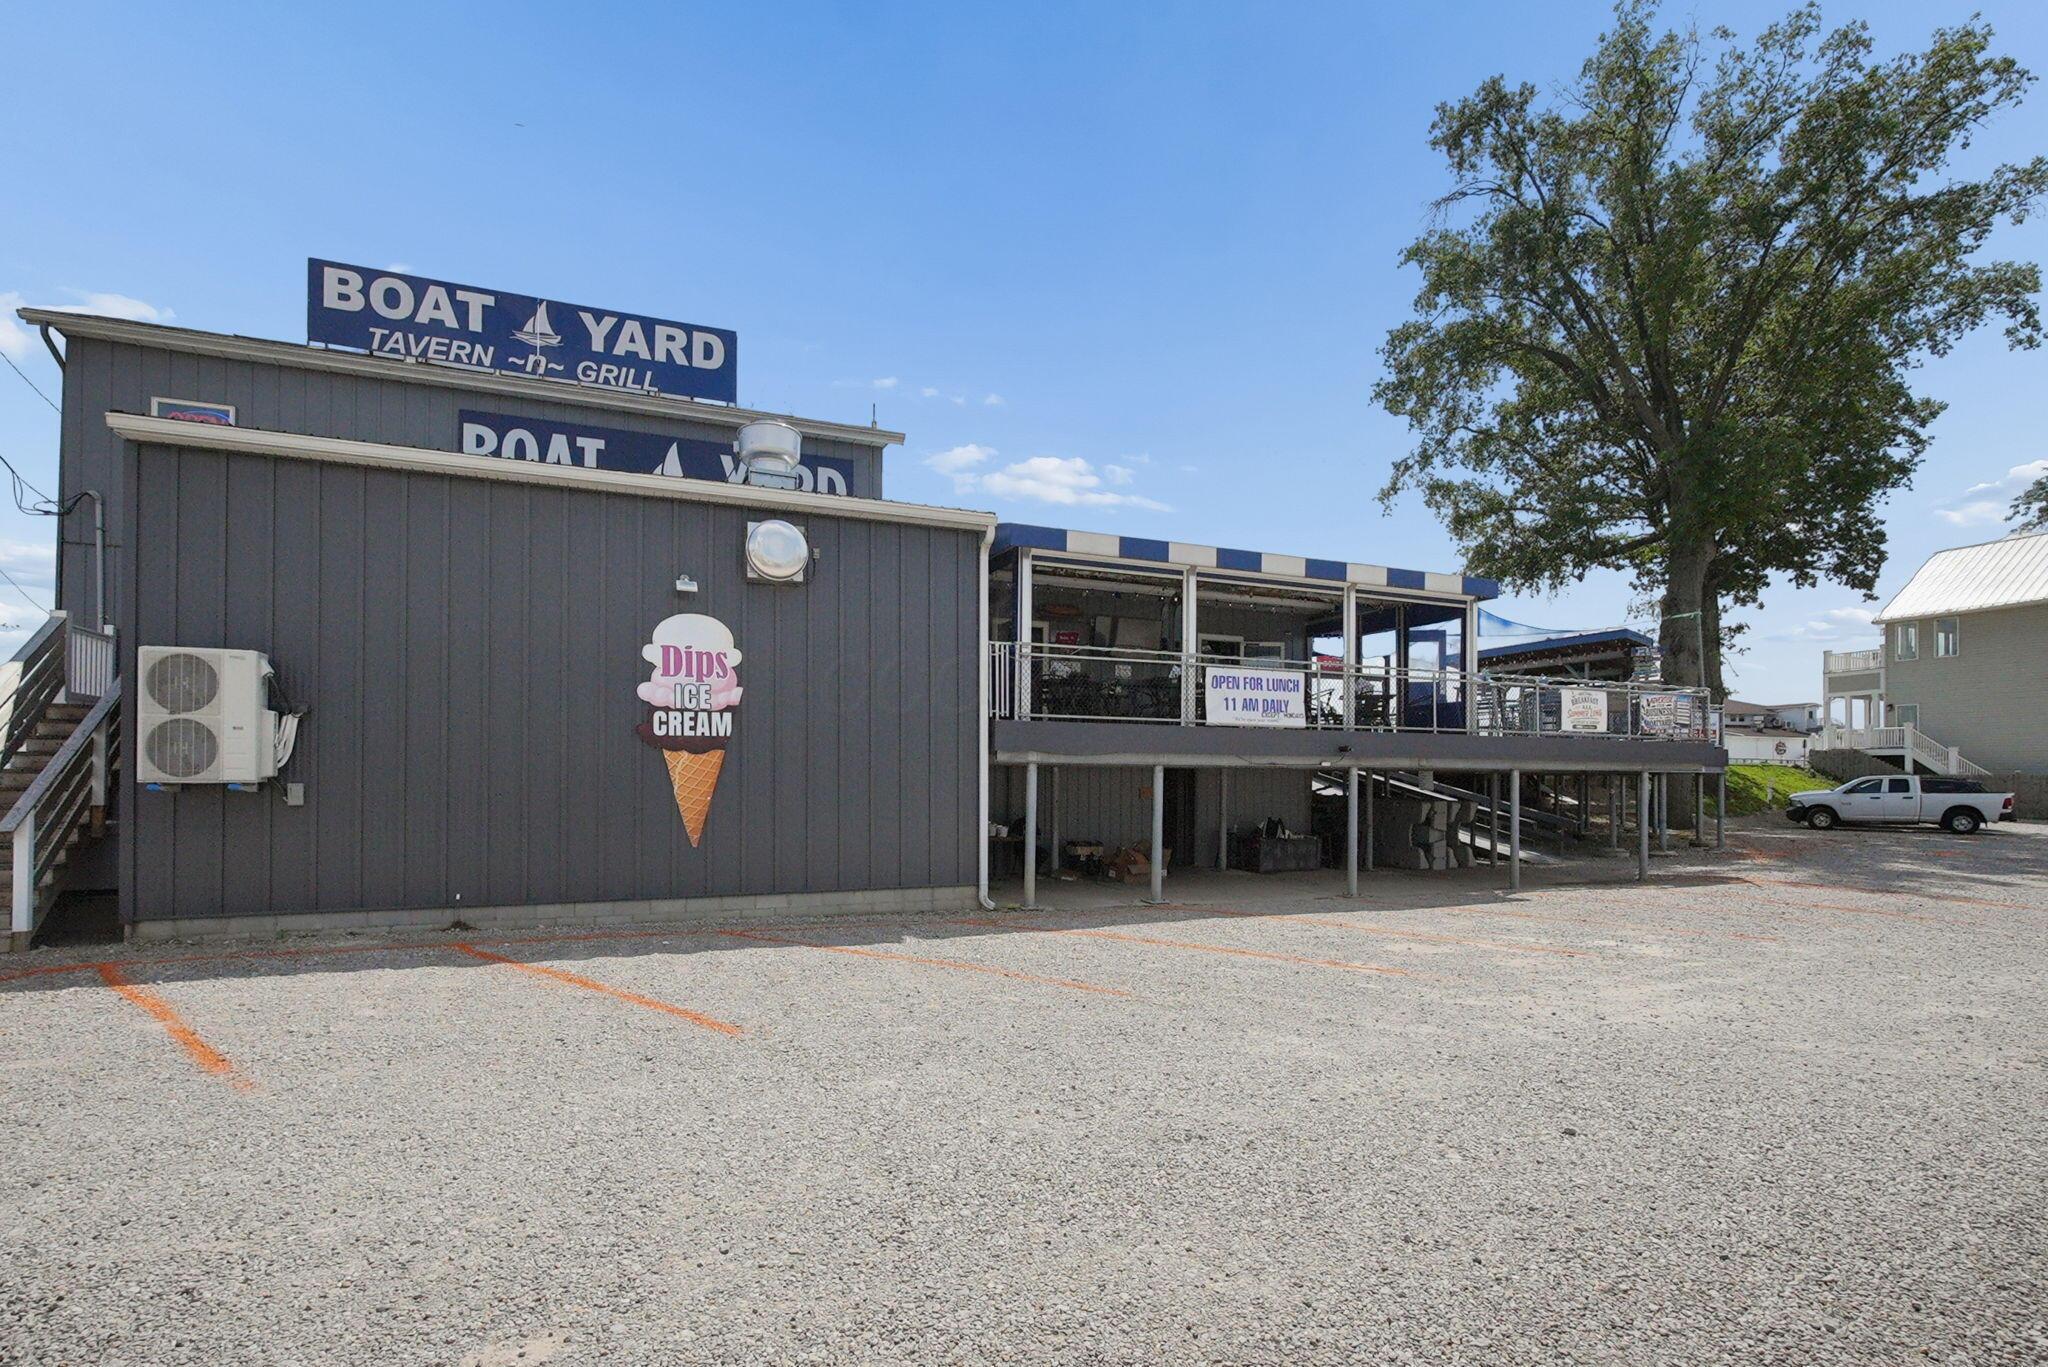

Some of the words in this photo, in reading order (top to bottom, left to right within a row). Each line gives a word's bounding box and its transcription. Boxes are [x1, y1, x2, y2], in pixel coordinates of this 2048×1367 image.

[323, 266, 495, 332] BOAT
[577, 310, 726, 370] YARD
[368, 326, 494, 366] TAVERN
[577, 360, 659, 393] GRILL
[660, 645, 728, 683] Dips
[674, 682, 713, 710] ICE
[1211, 675, 1240, 690] OPEN
[1243, 676, 1263, 691] FOR
[1266, 678, 1300, 693] LUNCH
[1223, 697, 1237, 711] 11
[1241, 697, 1259, 712] AM
[1262, 699, 1290, 714] DAILY
[653, 710, 733, 737] CREAM
